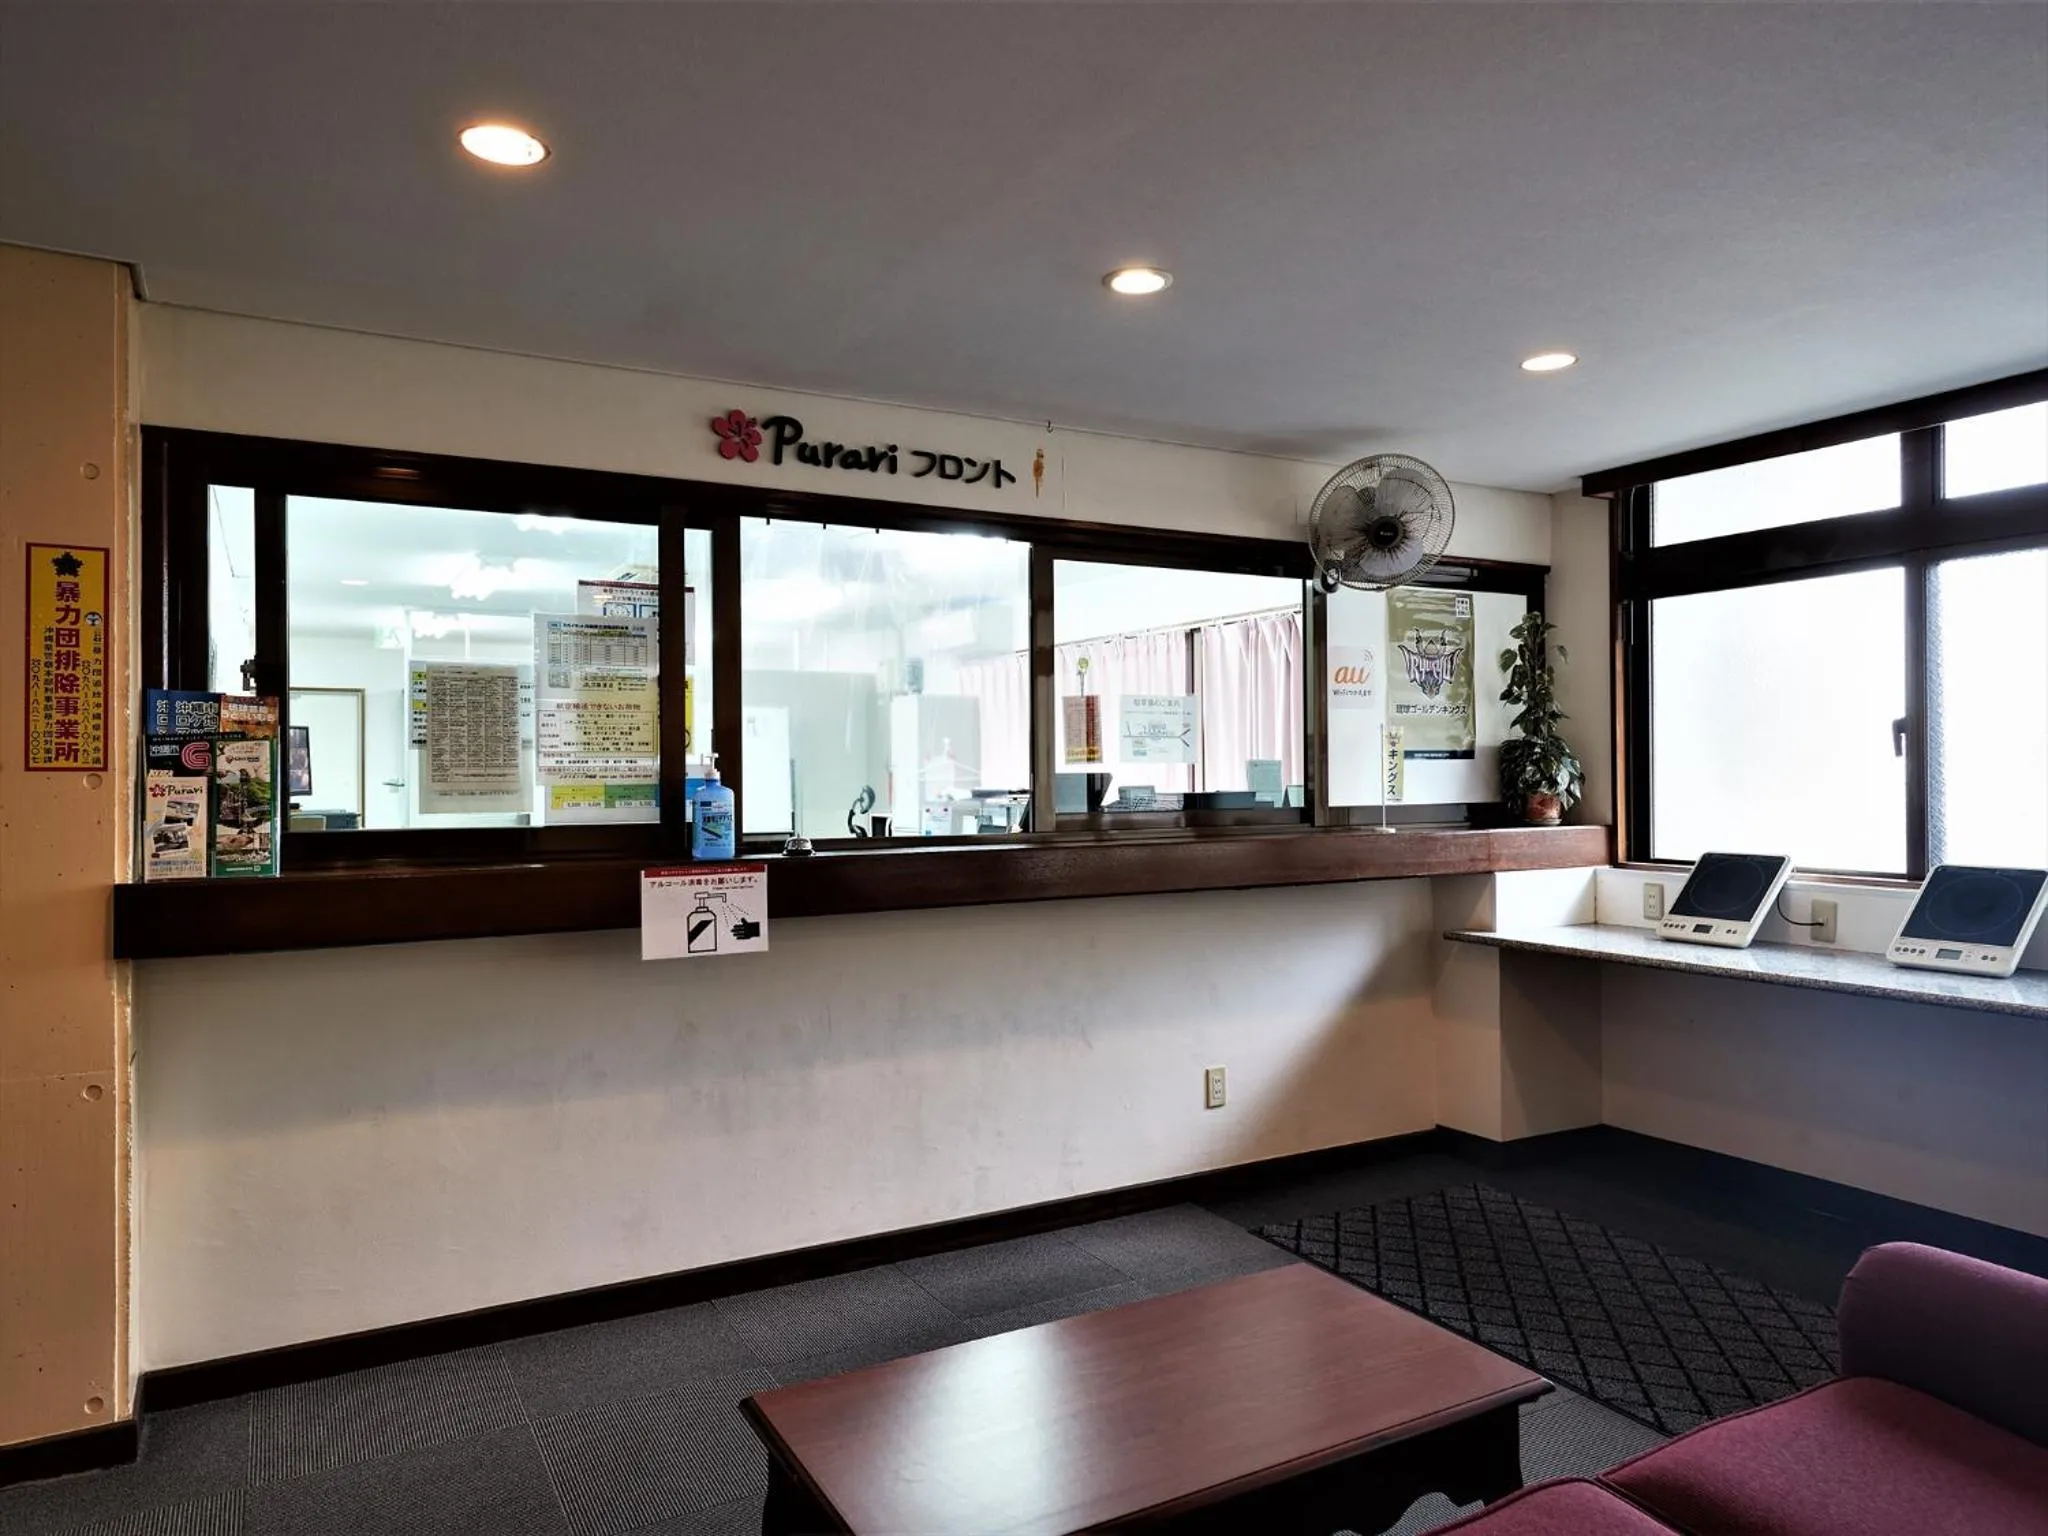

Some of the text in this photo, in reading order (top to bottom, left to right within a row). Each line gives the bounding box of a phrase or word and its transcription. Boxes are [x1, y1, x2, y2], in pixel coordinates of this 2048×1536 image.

[761, 416, 1016, 489] Purari フロント
[54, 580, 81, 763] 暴力団排除事業所
[1333, 665, 1371, 685] au
[175, 700, 219, 714] 沖縄市
[175, 714, 219, 728] ロケ地
[1386, 748, 1399, 796] キングス
[166, 784, 203, 797] Purari
[649, 875, 758, 888] アルコール消毒をお願いします。
